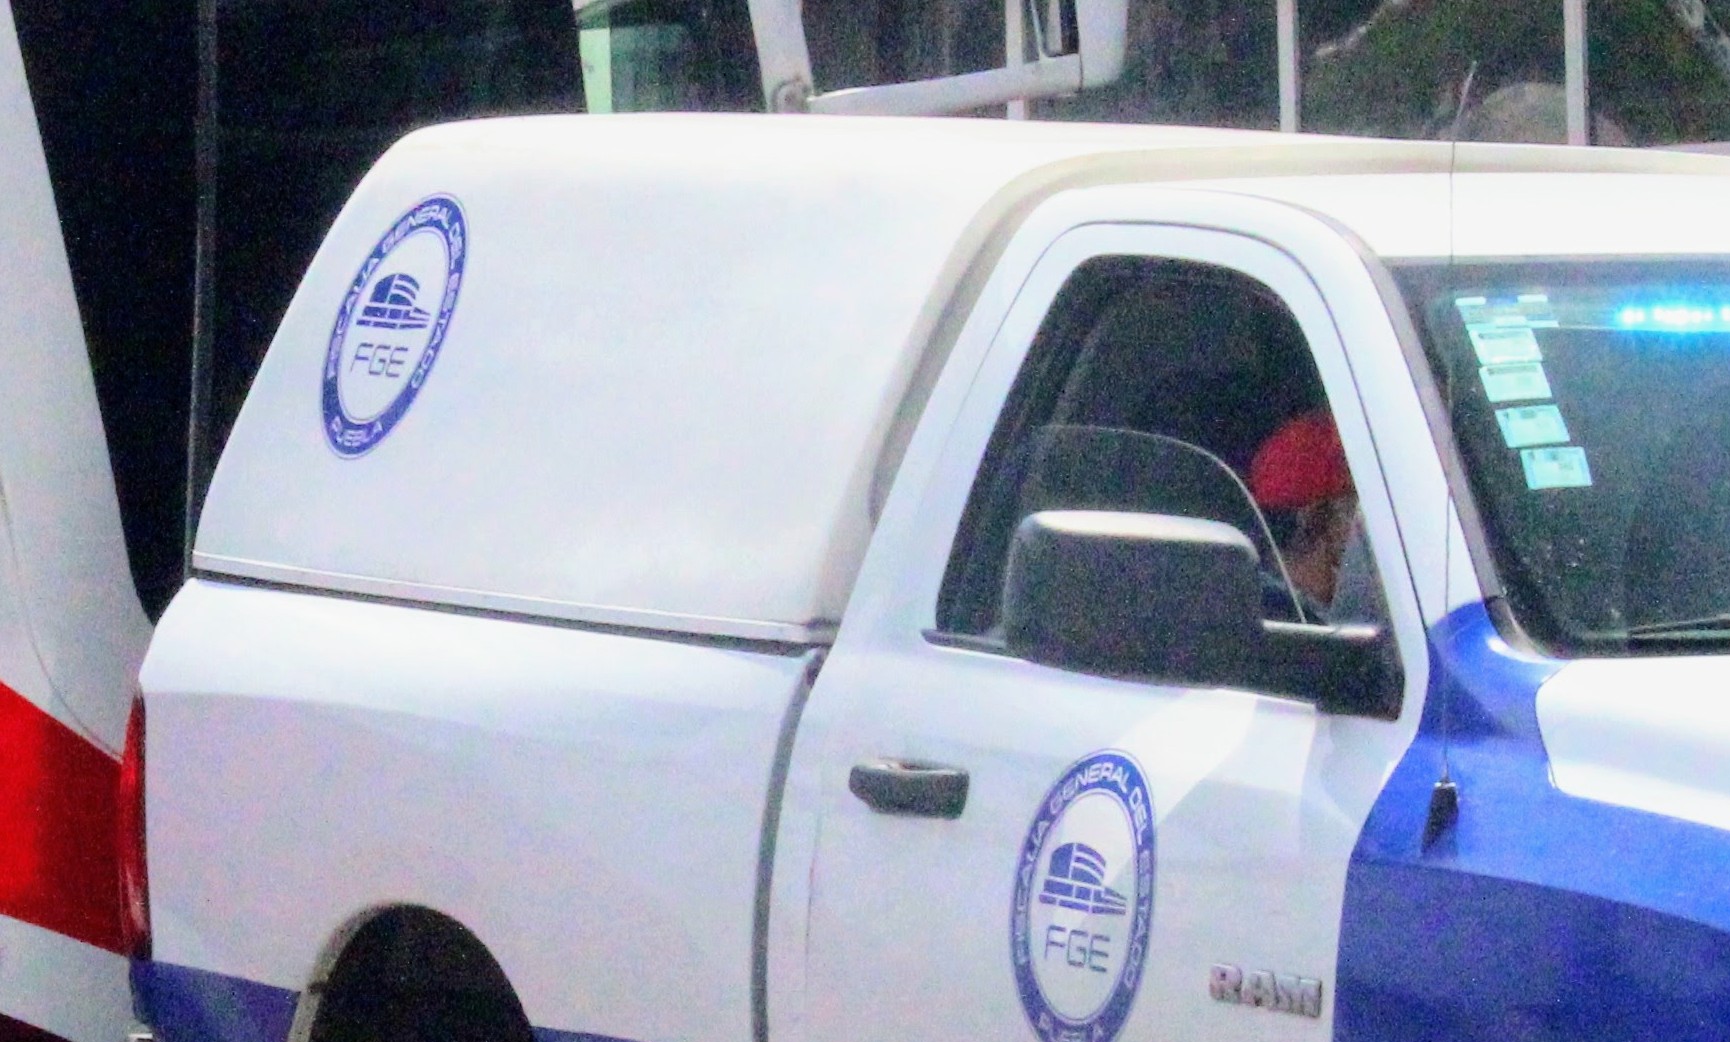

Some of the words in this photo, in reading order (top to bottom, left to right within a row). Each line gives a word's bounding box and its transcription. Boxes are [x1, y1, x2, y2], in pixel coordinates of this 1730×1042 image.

[382, 204, 450, 254] GENERAL
[450, 222, 464, 271] DEL
[350, 342, 409, 378] FGE
[331, 414, 384, 447] PUEBLA
[1050, 760, 1130, 815] GENERAL
[1129, 786, 1150, 845] DEL
[1044, 924, 1111, 973] FGE
[1209, 963, 1322, 1018] RAM
